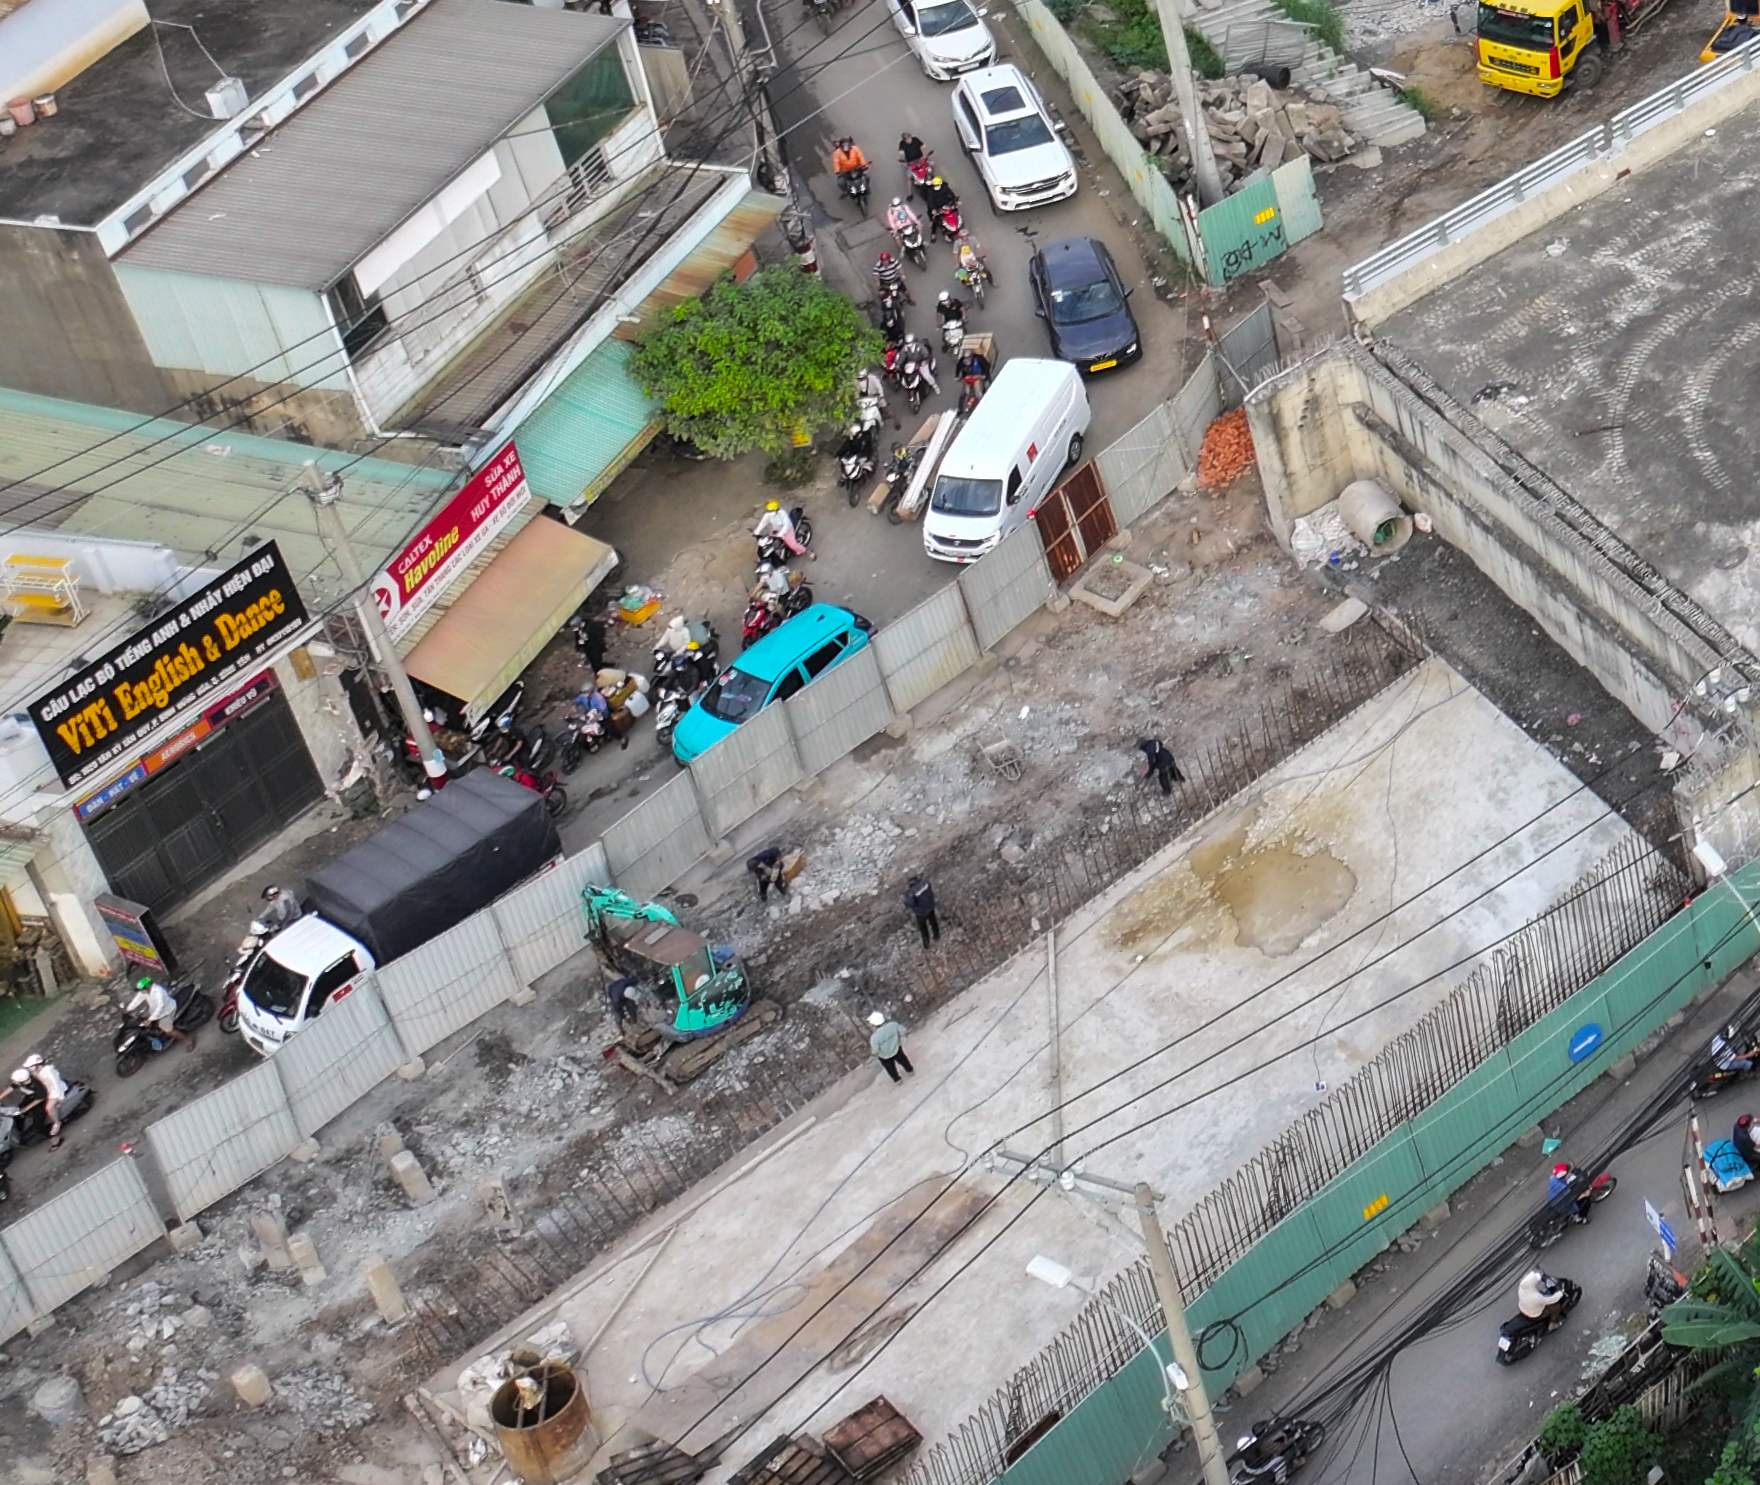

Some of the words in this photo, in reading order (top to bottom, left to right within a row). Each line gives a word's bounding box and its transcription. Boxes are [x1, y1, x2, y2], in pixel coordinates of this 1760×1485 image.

[471, 496, 489, 521] HUY
[491, 465, 520, 499] THÀNH
[485, 465, 503, 487] SỬA
[503, 451, 515, 467] XE
[399, 535, 432, 573] CALTEX
[405, 527, 458, 591] Havoline
[41, 695, 69, 721] CÂU
[69, 678, 95, 702] LẠC
[95, 664, 114, 685] BỘ
[115, 639, 152, 670] TIẾNG
[152, 620, 179, 646] ANH
[179, 613, 191, 627] &
[190, 589, 222, 619] NHẢY
[223, 570, 252, 597] HIỆN
[252, 555, 274, 577] ĐẠI
[58, 699, 116, 752] ViTi
[116, 645, 203, 718] English
[202, 635, 220, 661] &
[215, 591, 283, 649] Dance
